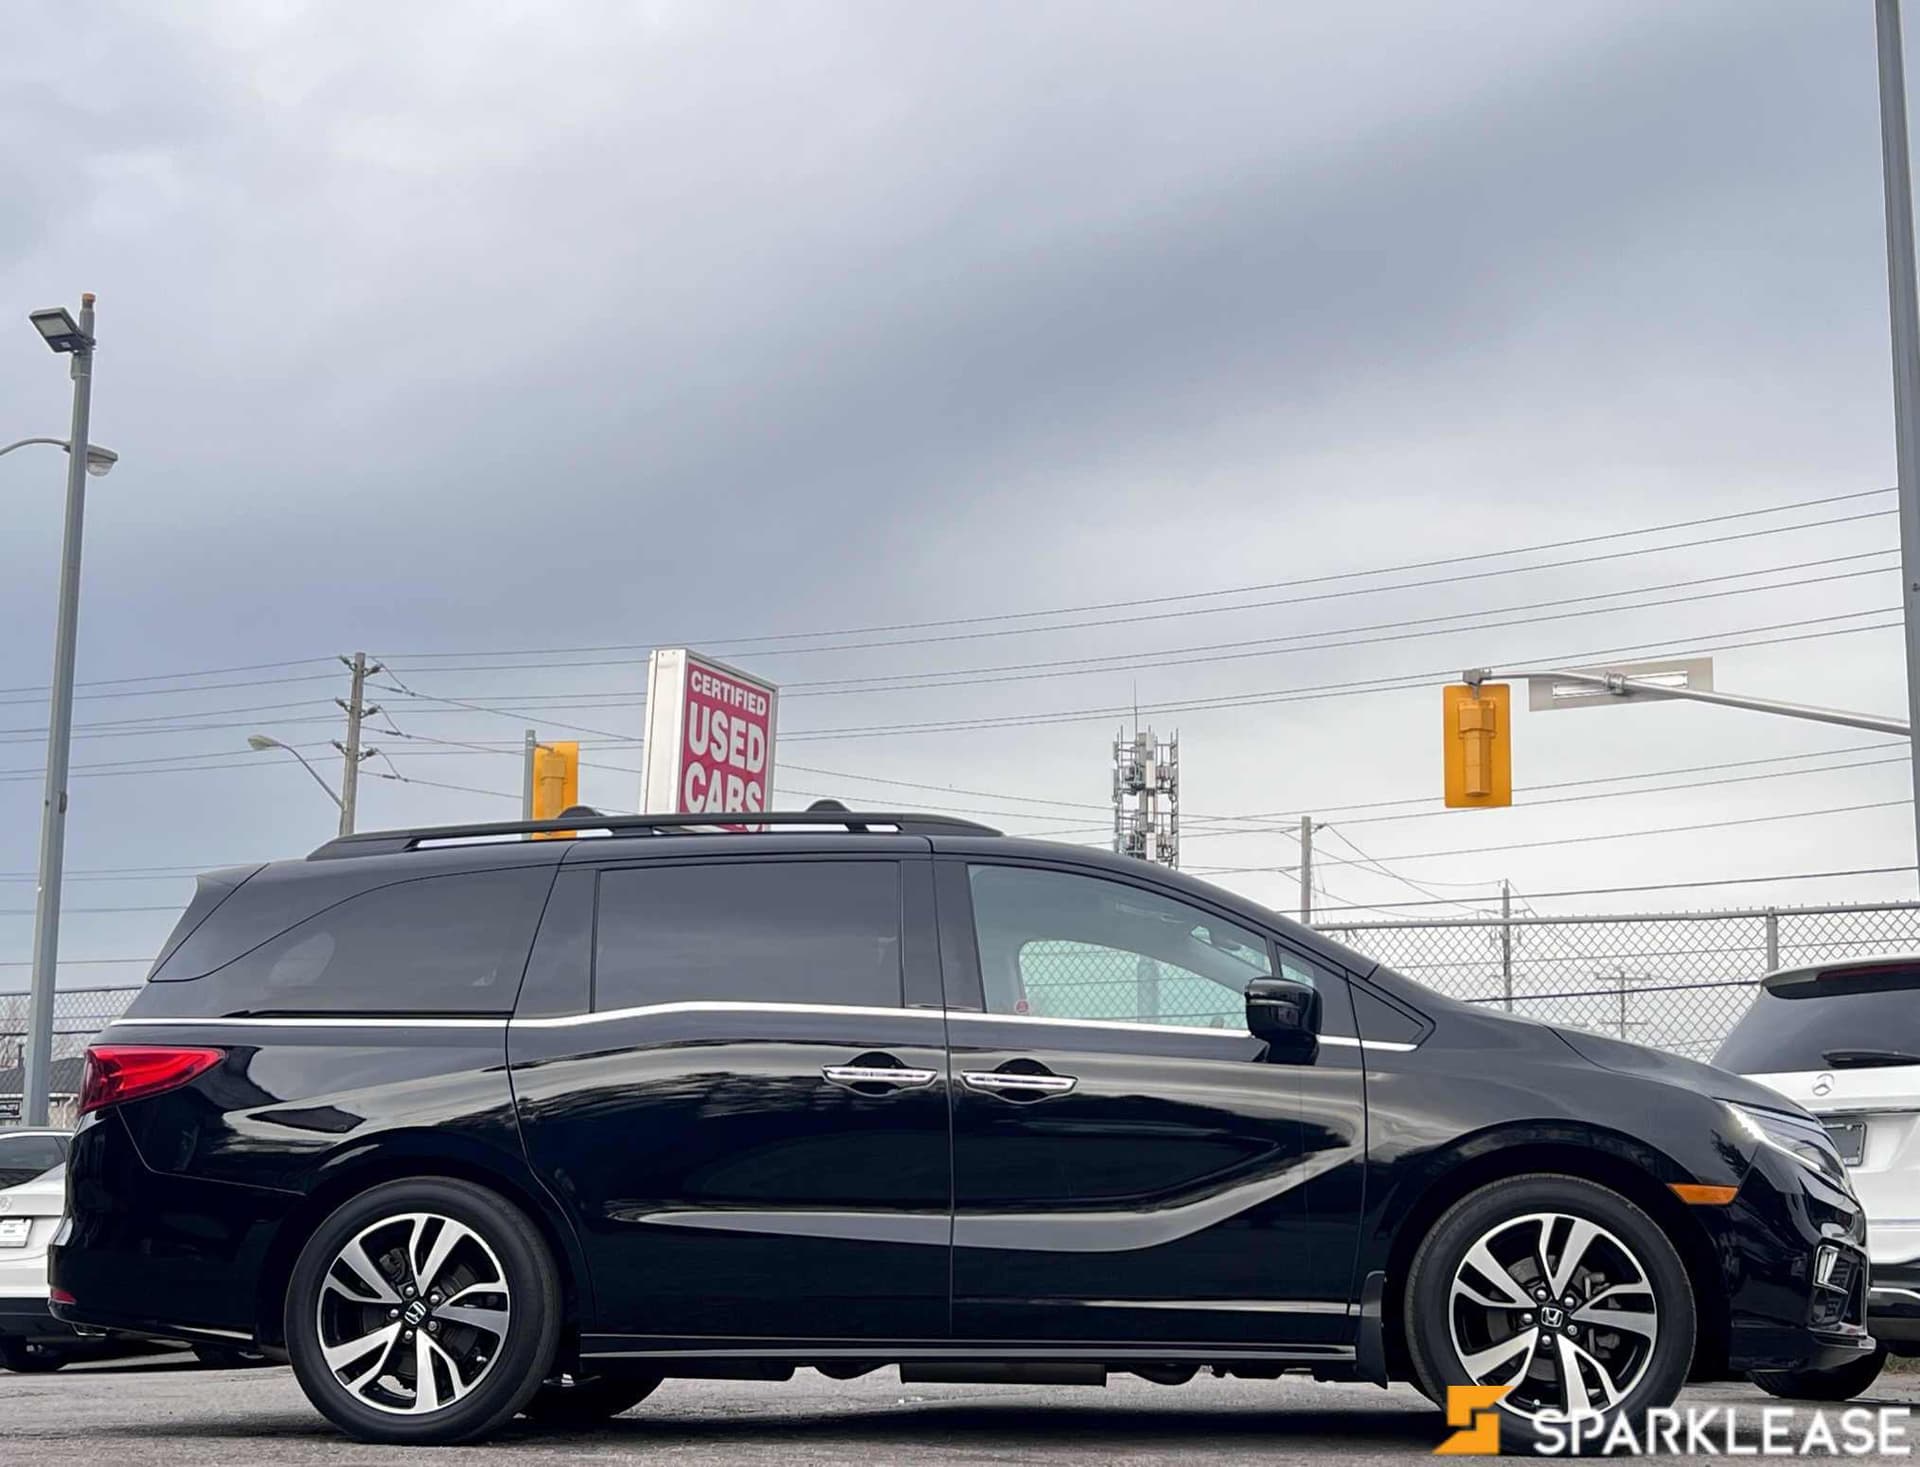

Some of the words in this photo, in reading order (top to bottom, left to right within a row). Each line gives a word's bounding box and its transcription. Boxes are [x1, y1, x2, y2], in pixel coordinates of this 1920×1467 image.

[691, 671, 766, 716] CERTIFIED
[689, 702, 765, 773] USED
[685, 762, 762, 815] CARS
